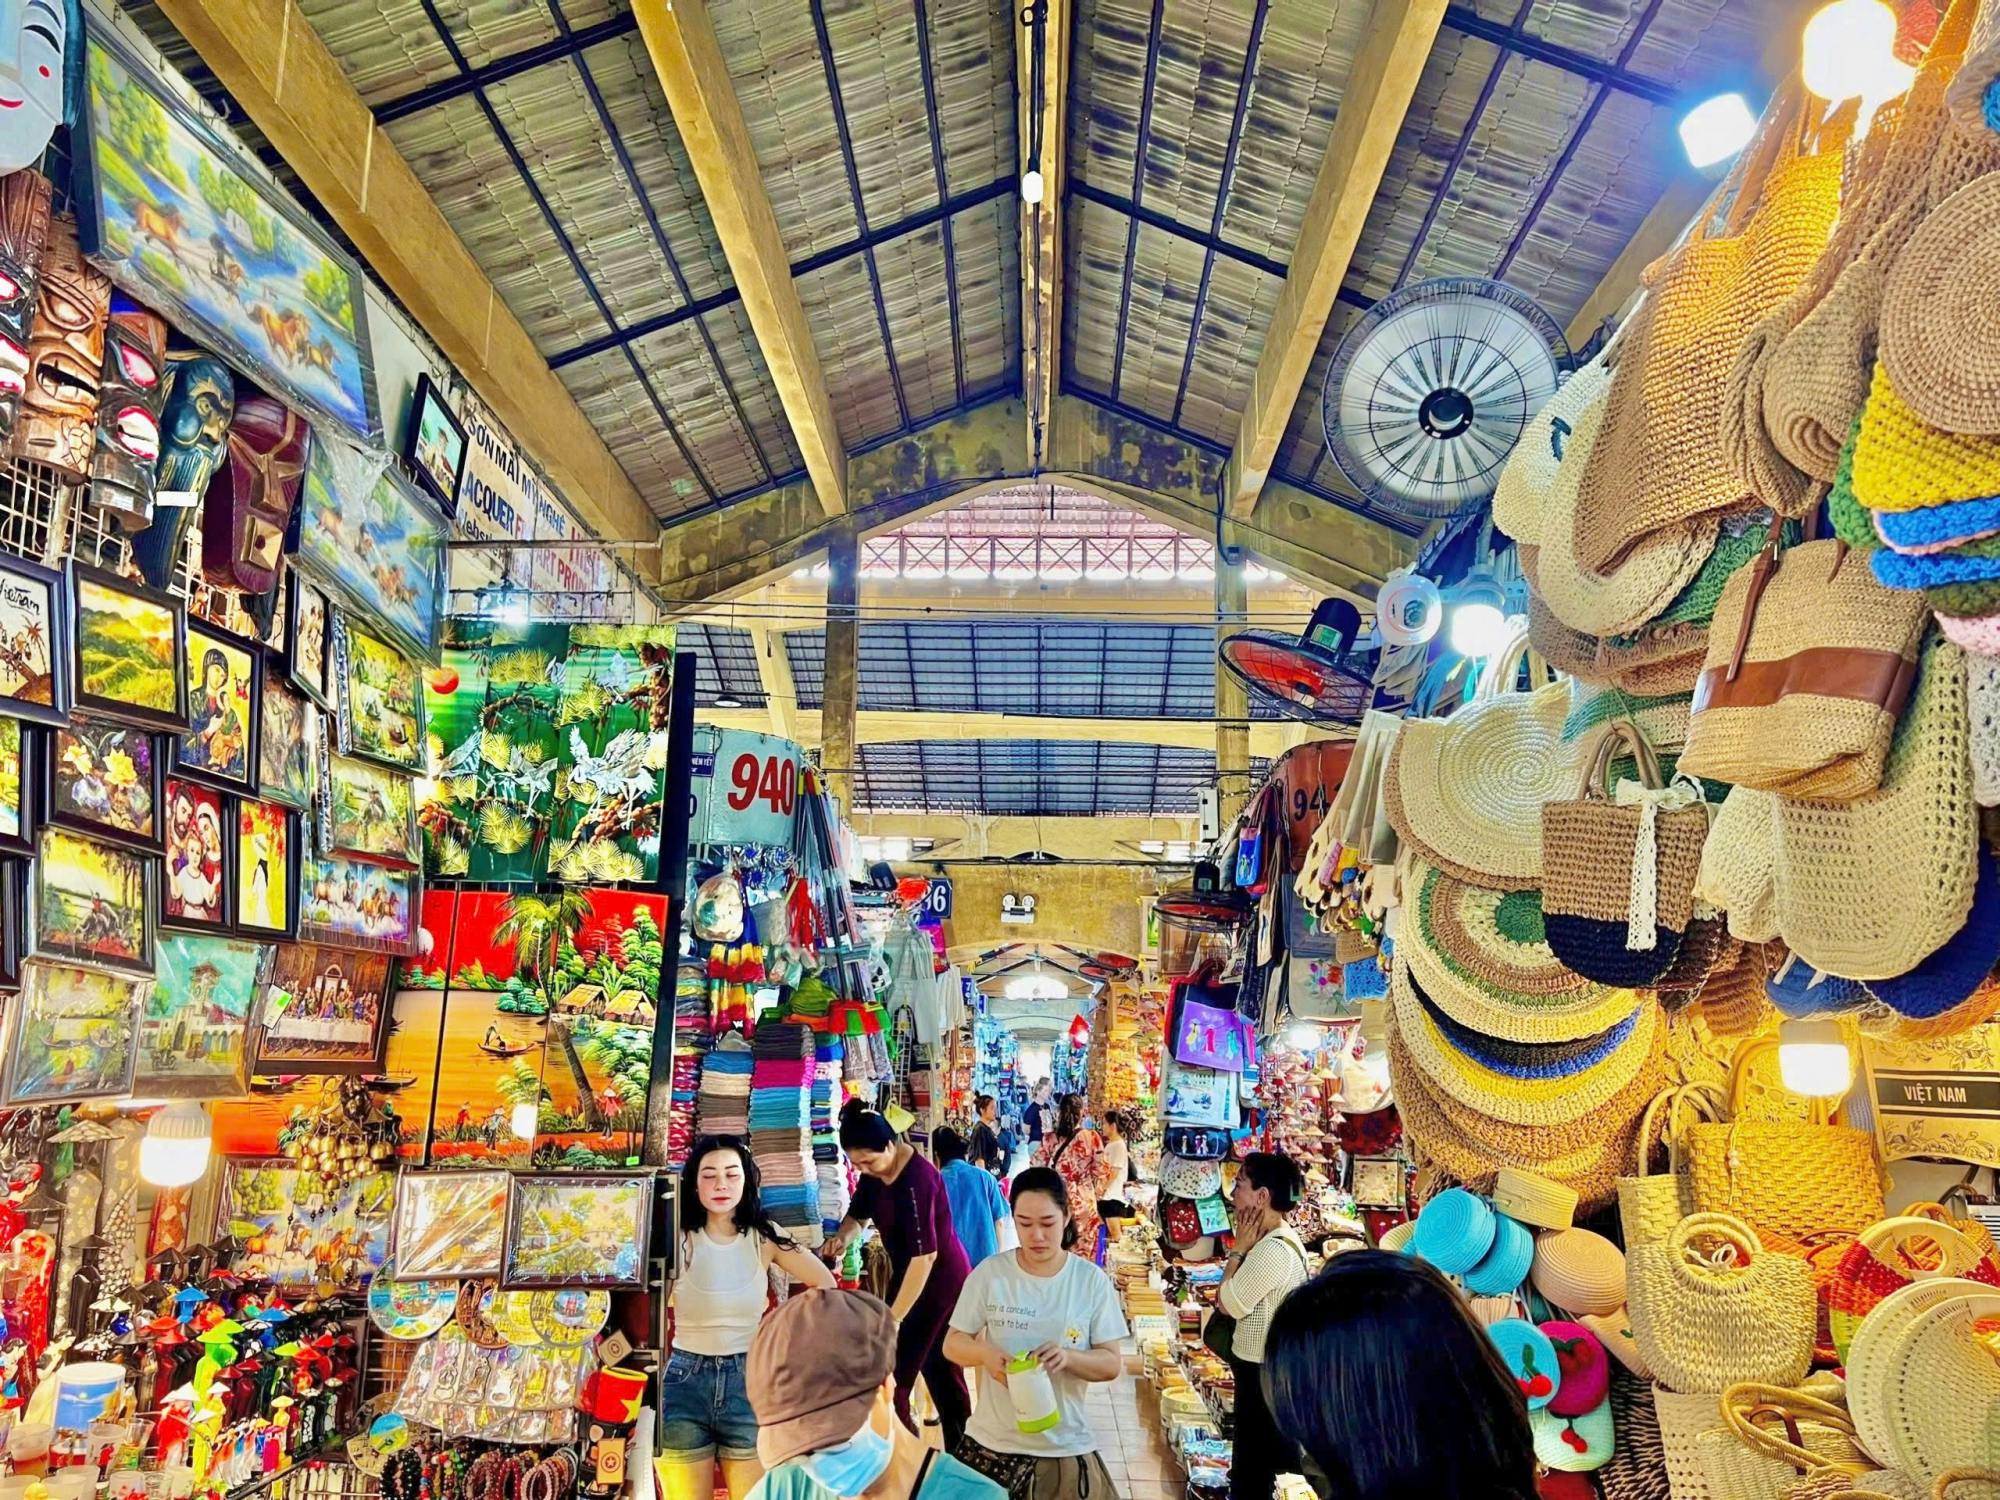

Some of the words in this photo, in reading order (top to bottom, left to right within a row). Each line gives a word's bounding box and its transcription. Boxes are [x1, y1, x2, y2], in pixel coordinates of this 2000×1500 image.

[462, 470, 514, 536] ACQUER
[727, 753, 795, 816] 940
[1294, 782, 1342, 821] 94
[1903, 1082, 1932, 1104] VIỆT
[1937, 1086, 1967, 1103] NAM
